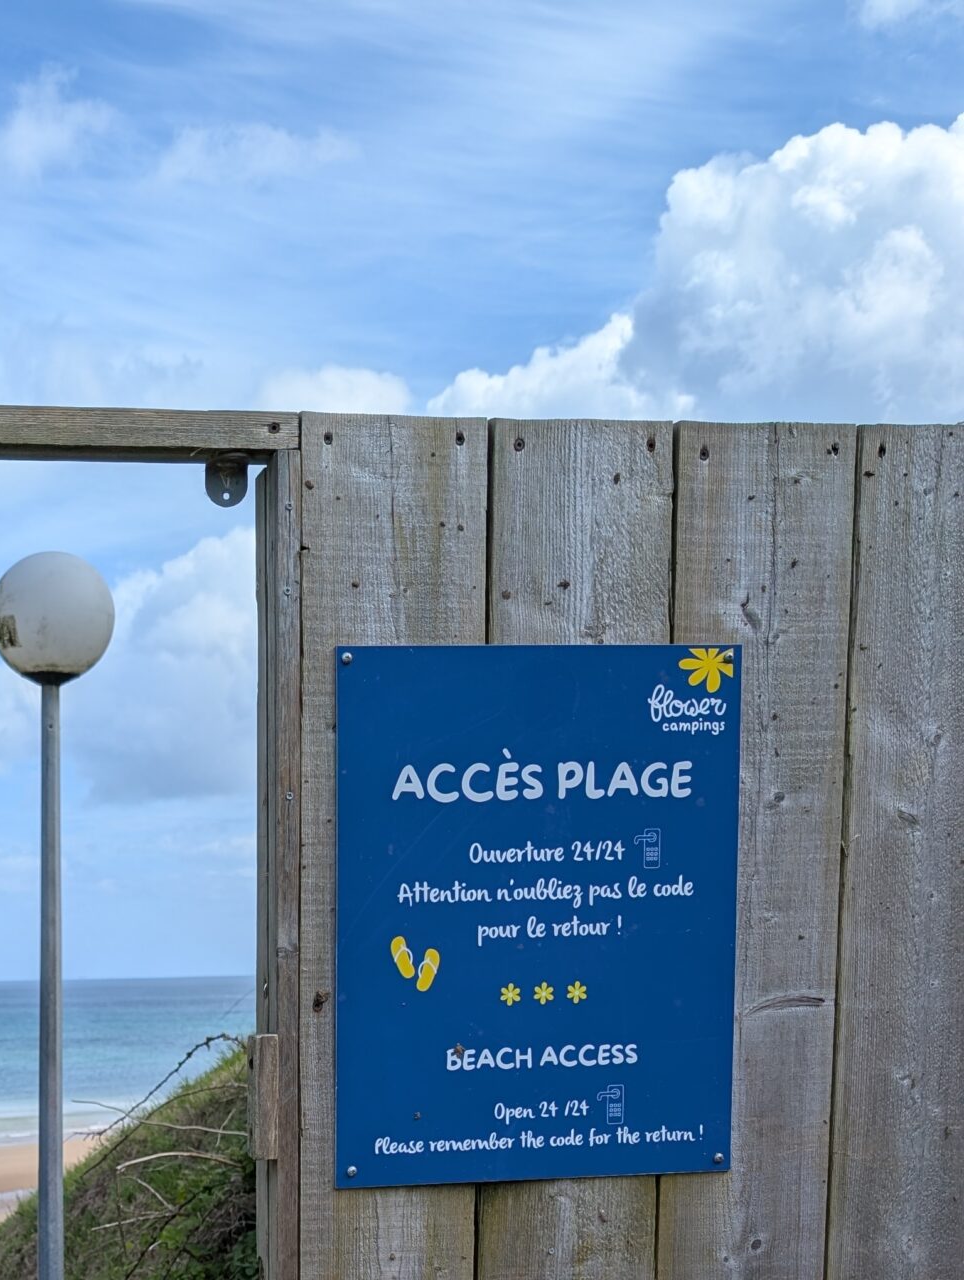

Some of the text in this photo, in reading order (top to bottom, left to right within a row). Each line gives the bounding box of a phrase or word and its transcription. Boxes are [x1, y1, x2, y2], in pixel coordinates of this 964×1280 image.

[647, 684, 727, 723] flower
[662, 721, 725, 736] campings
[391, 748, 693, 803] ACCÈS PLAGE
[469, 840, 626, 864] Ouverture 24/24
[397, 874, 694, 909] Attention n'oubliez pas le code
[477, 914, 624, 947] pour le retour !
[446, 1043, 638, 1071] BEACH ACCESS
[494, 1102, 535, 1125] Open
[374, 1123, 705, 1155] Please remember the code for the return !
